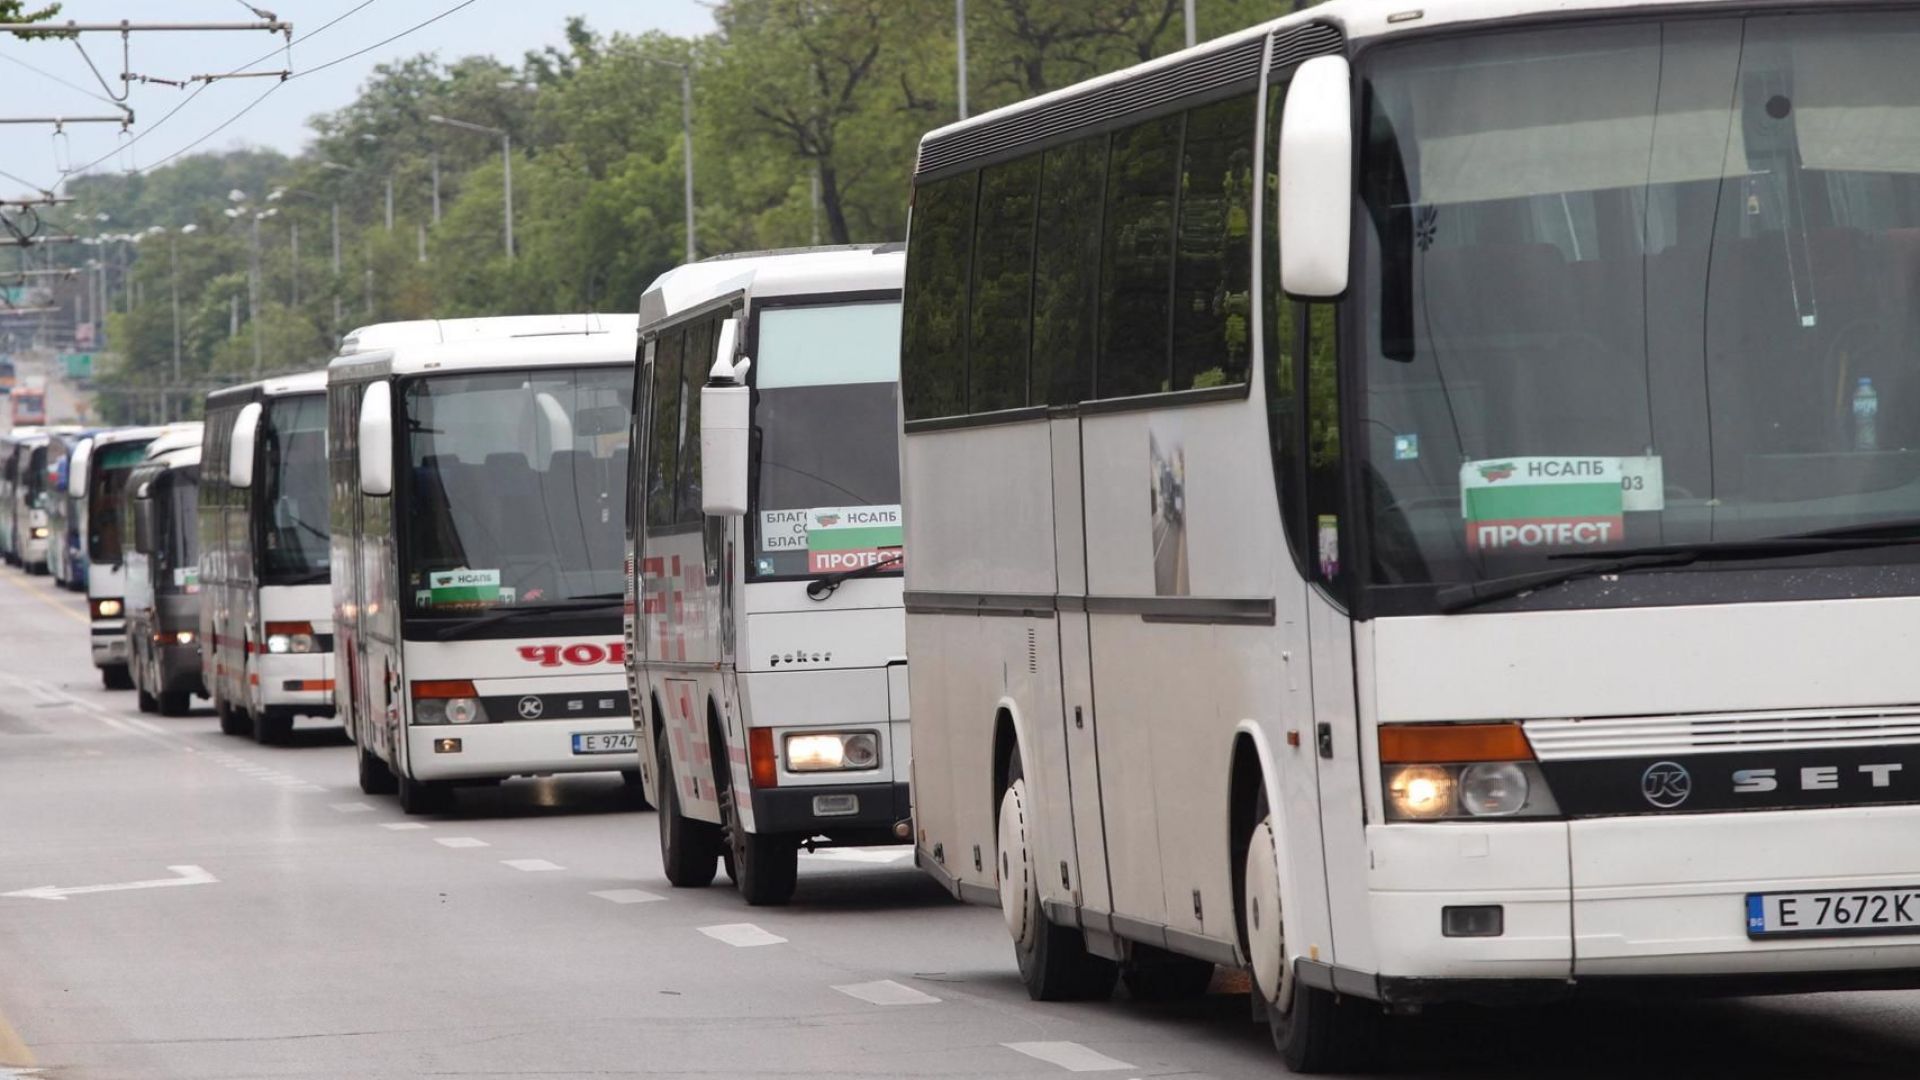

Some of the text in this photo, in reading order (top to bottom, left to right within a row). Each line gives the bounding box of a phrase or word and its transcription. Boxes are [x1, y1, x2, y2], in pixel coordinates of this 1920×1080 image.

[1528, 460, 1604, 477] НСАПБ
[767, 511, 807, 523] БЛАГ
[847, 511, 897, 523] НСАПБ
[768, 535, 809, 547] БЛАГ
[1478, 522, 1612, 548] ПРОТЕСТ
